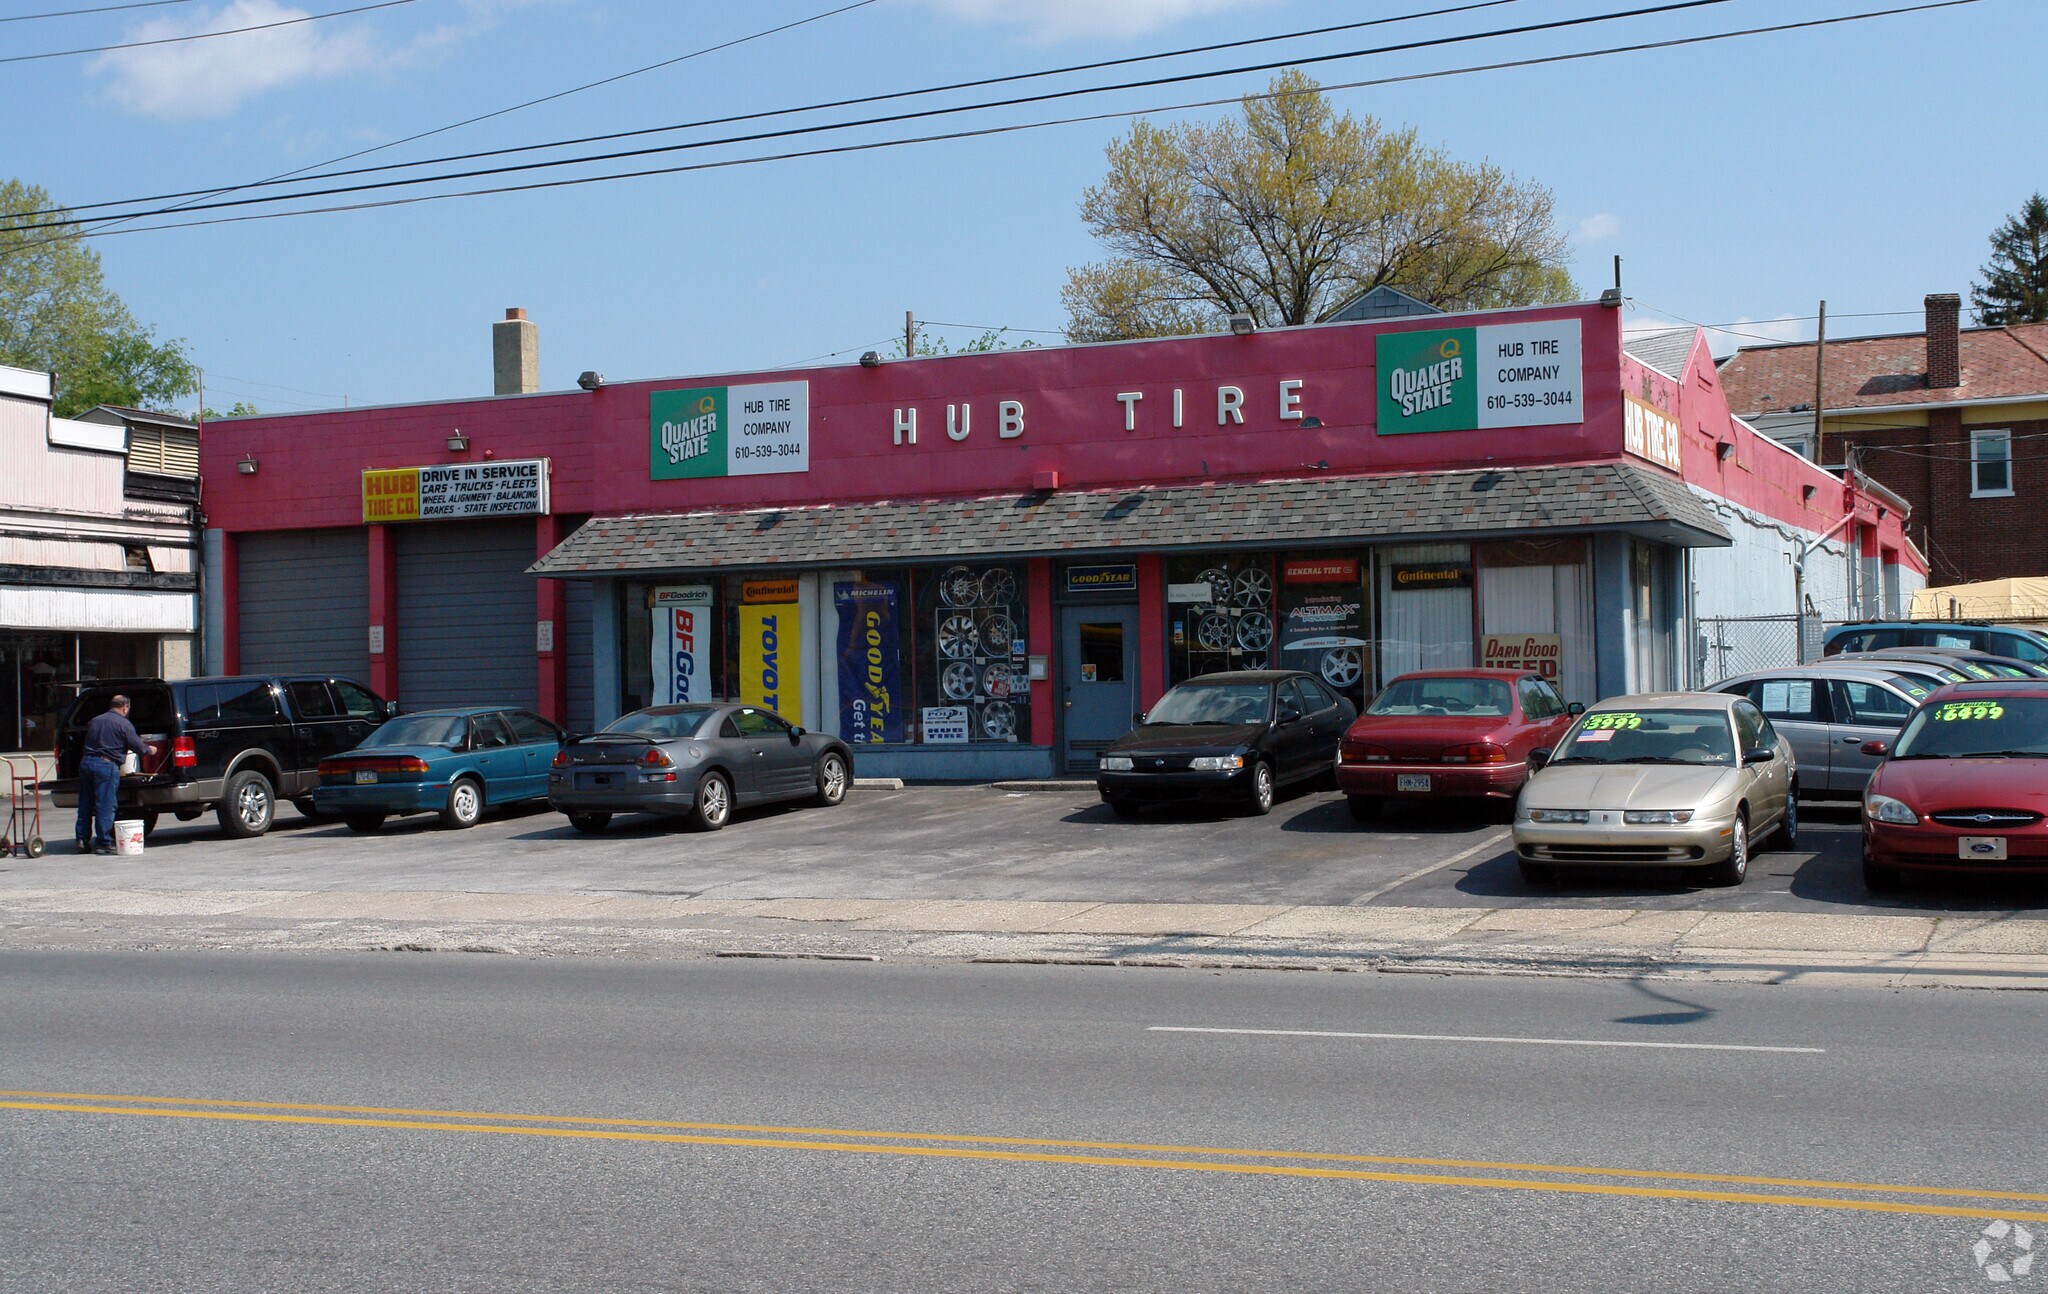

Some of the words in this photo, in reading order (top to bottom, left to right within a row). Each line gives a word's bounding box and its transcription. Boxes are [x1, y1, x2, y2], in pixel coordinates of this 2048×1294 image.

[1498, 343, 1524, 358] HUB
[1531, 340, 1559, 355] TIRE
[1391, 357, 1463, 403] QUAKER
[1498, 365, 1560, 383] COMPANY
[744, 400, 764, 414] HUB
[769, 399, 791, 412] TIRE
[1402, 382, 1452, 417] STATE
[1487, 391, 1572, 409] 610-539-3044
[893, 400, 1025, 446] HUB
[1117, 379, 1303, 431] TIRE
[661, 412, 717, 452] QUAKER
[744, 421, 791, 436] COMPANY
[1624, 398, 1644, 451] HUB
[1644, 408, 1666, 461] TIRE
[669, 435, 709, 464] STATE
[735, 443, 800, 459] 610-539-3044
[422, 469, 460, 482] DRIVE
[465, 468, 478, 480] IN
[482, 465, 537, 478] SERVICE
[366, 473, 416, 496] HUB
[422, 482, 448, 494] CARS
[454, 481, 493, 492] TRUCKS
[500, 478, 537, 490] FLEETS
[422, 495, 447, 505] WHEEL
[448, 492, 492, 503] ALIGNMENT
[495, 490, 538, 500] BALANCING
[366, 499, 393, 517] TIRE
[423, 504, 454, 515] BRAKES
[464, 503, 487, 513] STATE
[490, 501, 537, 512] INSPECTION
[1071, 571, 1130, 583] GOODYEAR
[1287, 567, 1322, 575] GENERAL
[1323, 566, 1341, 574] TIRE
[1397, 568, 1459, 584] Continental
[659, 590, 708, 600] BFGoodrich
[746, 584, 795, 598] Continental
[850, 589, 894, 597] MICHELIN
[1290, 604, 1355, 618] ALTIMAX
[1485, 639, 1521, 658] DARN
[1523, 637, 1558, 658] GOOD
[853, 699, 866, 728] Get
[1934, 706, 2004, 721] $6499
[1582, 717, 1642, 730] $3999
